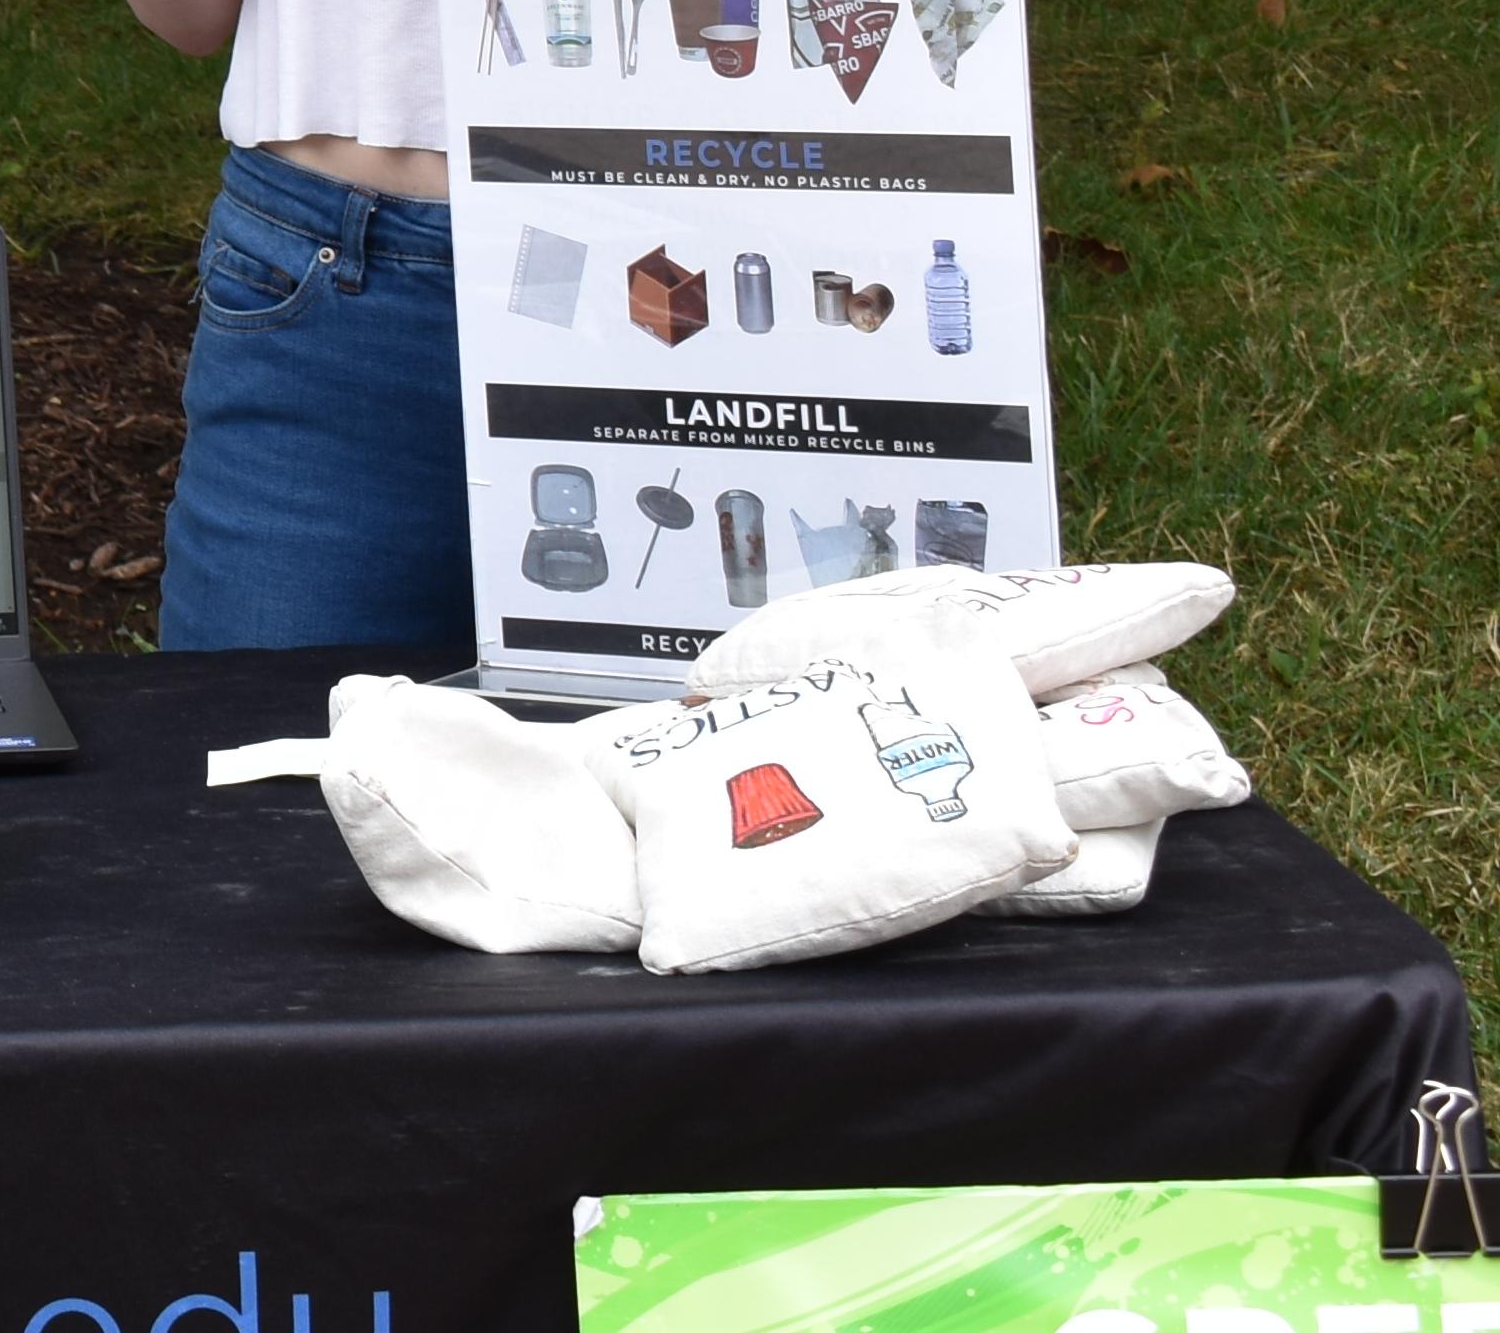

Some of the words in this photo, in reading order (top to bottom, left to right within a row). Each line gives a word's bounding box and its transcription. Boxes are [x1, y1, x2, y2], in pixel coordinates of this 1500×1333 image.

[644, 138, 825, 169] RECYCLE
[551, 170, 597, 184] MUST
[604, 171, 626, 184] BE
[633, 172, 690, 185] CLEAN
[697, 173, 708, 185] &
[716, 174, 757, 188] DRY,
[764, 175, 789, 187] NO
[797, 176, 871, 190] PLASTIC
[879, 177, 928, 191] BAGS
[665, 397, 859, 433] LANDFILL
[593, 426, 680, 442] SEPARATE
[688, 430, 736, 445] FROM
[744, 433, 799, 447] MIXED
[807, 437, 885, 452] RECYCLE
[893, 441, 936, 454] BINS
[891, 741, 959, 770] WATER
